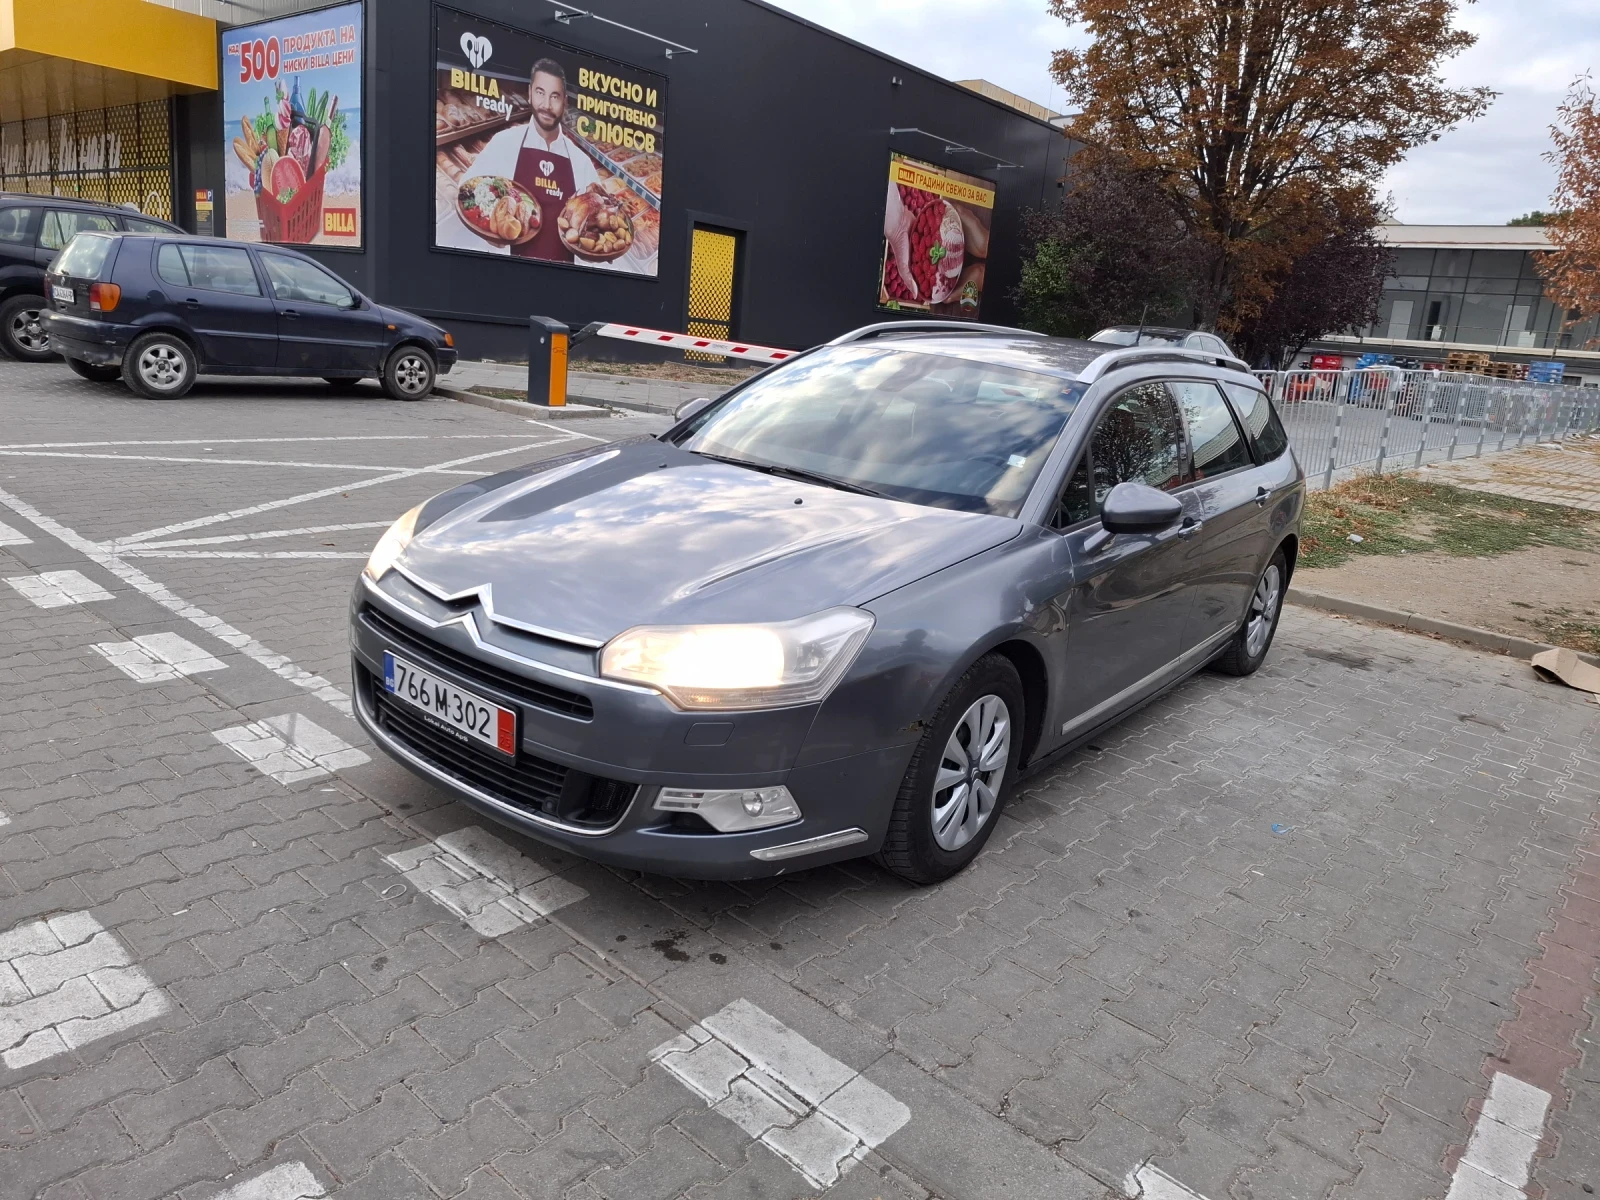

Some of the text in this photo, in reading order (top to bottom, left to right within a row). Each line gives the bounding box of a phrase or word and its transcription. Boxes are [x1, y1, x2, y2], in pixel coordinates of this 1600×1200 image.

[283, 25, 355, 54] ПРОДУКТА НА
[240, 35, 281, 84] 500
[283, 49, 355, 73] НИСКИ BILLA ЦЕНИ
[451, 67, 500, 99] BILLA
[578, 67, 657, 108] ВКУСНО И
[476, 94, 513, 121] ready
[577, 93, 657, 129] ПРИГОТВЕНО
[576, 115, 656, 154] С ЛЮБОВ
[535, 176, 557, 190] BILLA
[546, 187, 563, 201] ready
[915, 173, 945, 191] ГРАДИНИ
[945, 182, 967, 198] СВЕЖО
[967, 188, 975, 199] ЗА
[975, 192, 987, 203] ВАС
[324, 212, 355, 233] BILLA
[385, 676, 395, 687] BG
